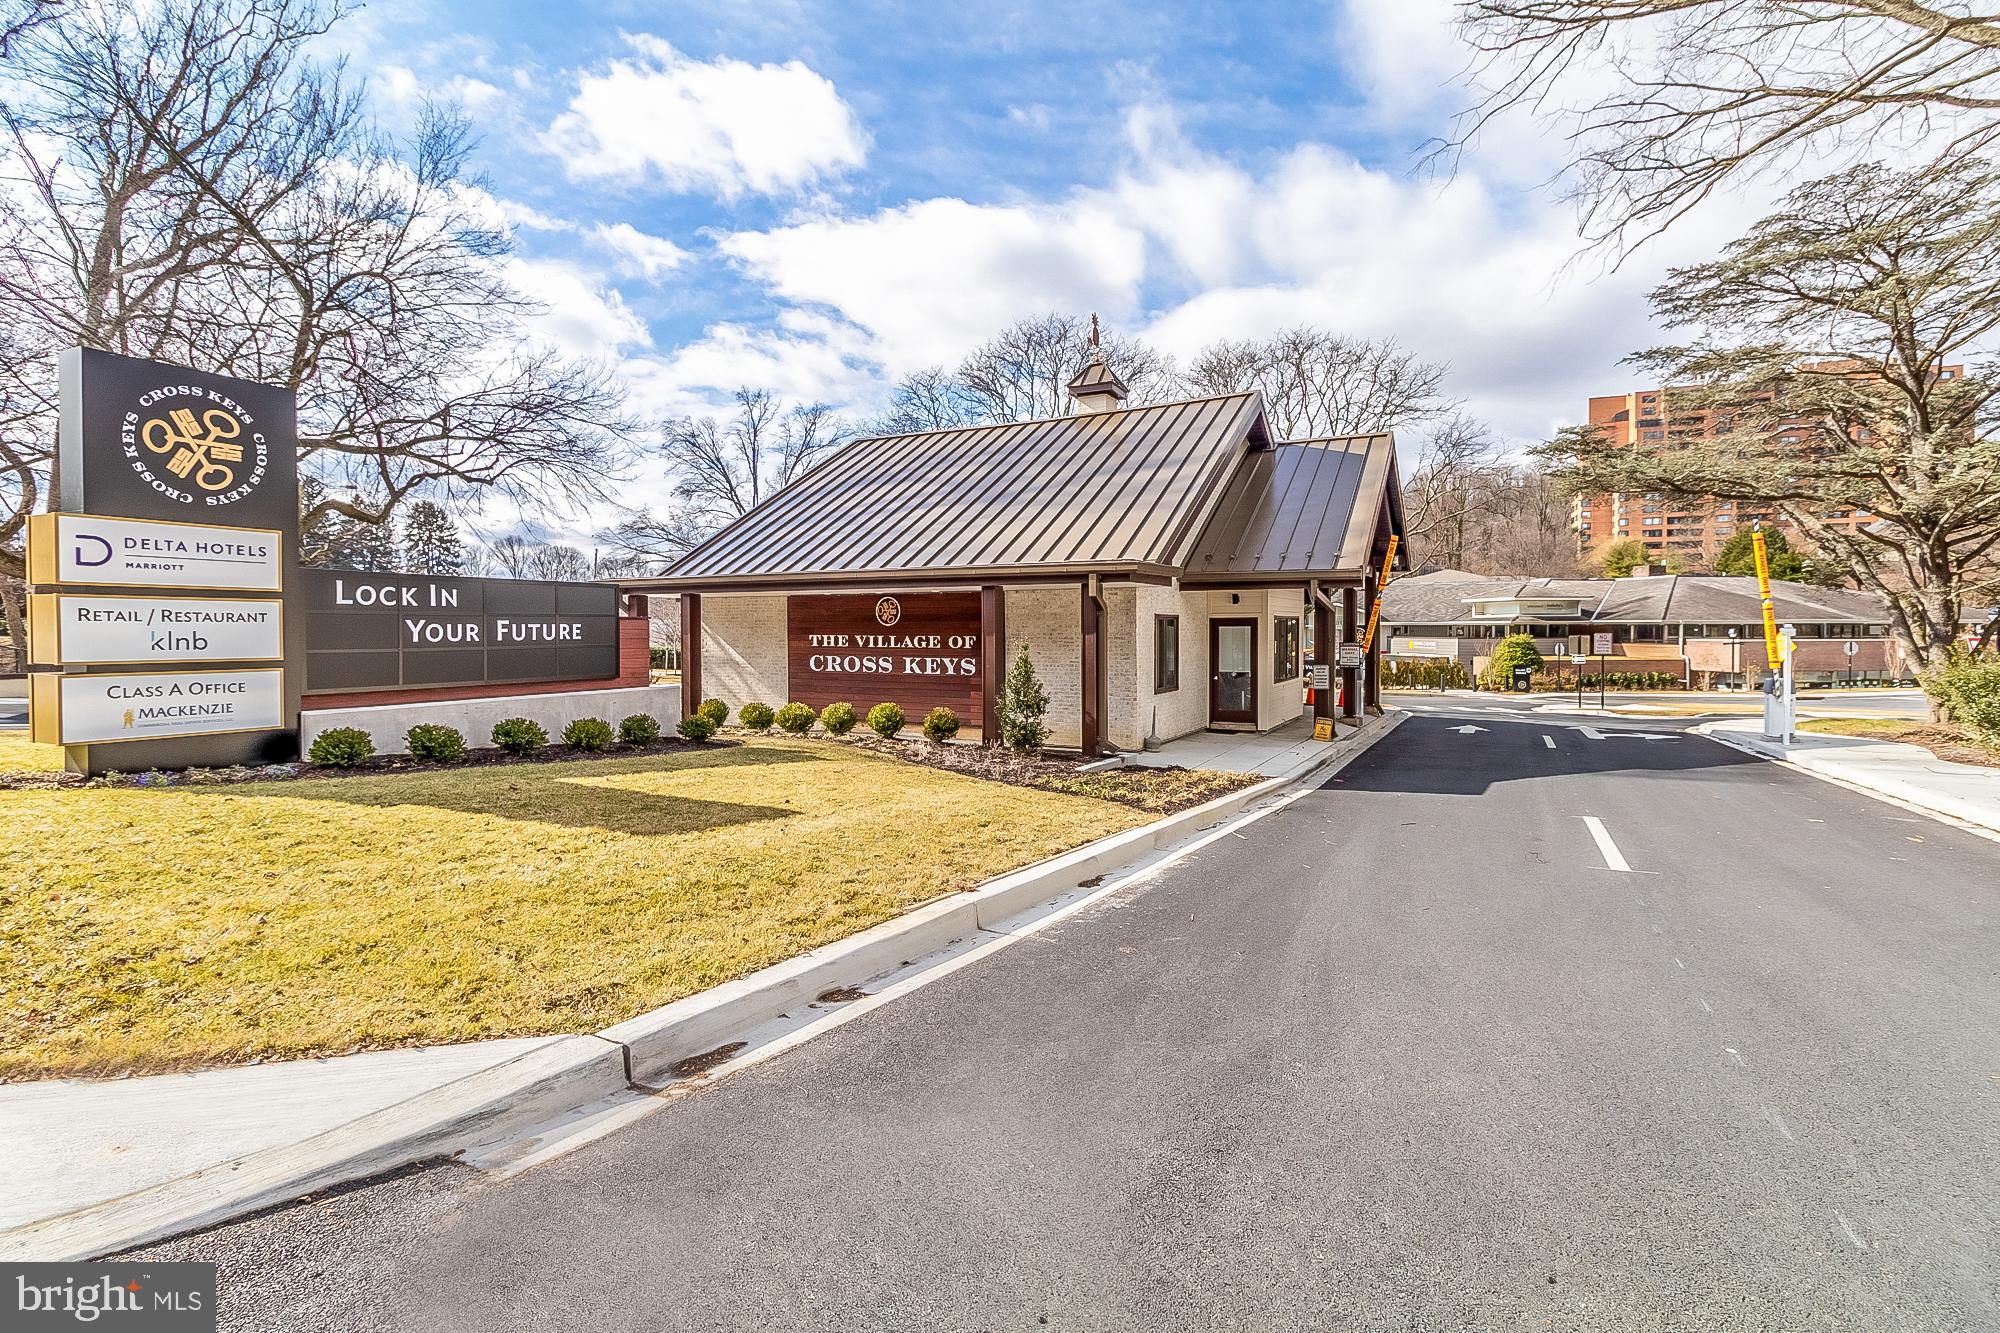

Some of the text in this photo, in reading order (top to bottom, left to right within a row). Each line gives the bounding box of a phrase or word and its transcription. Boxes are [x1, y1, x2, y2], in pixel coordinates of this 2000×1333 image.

[139, 385, 254, 424] CROSS KEYS
[122, 411, 194, 503] CROSS KEYS
[206, 432, 268, 506] CROSS KEYS
[124, 537, 267, 557] DELTA HOTELS
[125, 562, 185, 571] MARRIOTT
[335, 579, 458, 608] LOCK IN
[77, 607, 268, 626] RETAIL / RESTAURANT
[151, 630, 208, 651] klnb
[405, 619, 582, 642] YOUR FUTURE
[809, 634, 976, 649] THE VILLAGE OF
[809, 654, 976, 676] CROSS KEYS
[106, 682, 246, 699] CLASS A OFFICE
[138, 703, 234, 719] MACKENZIE
